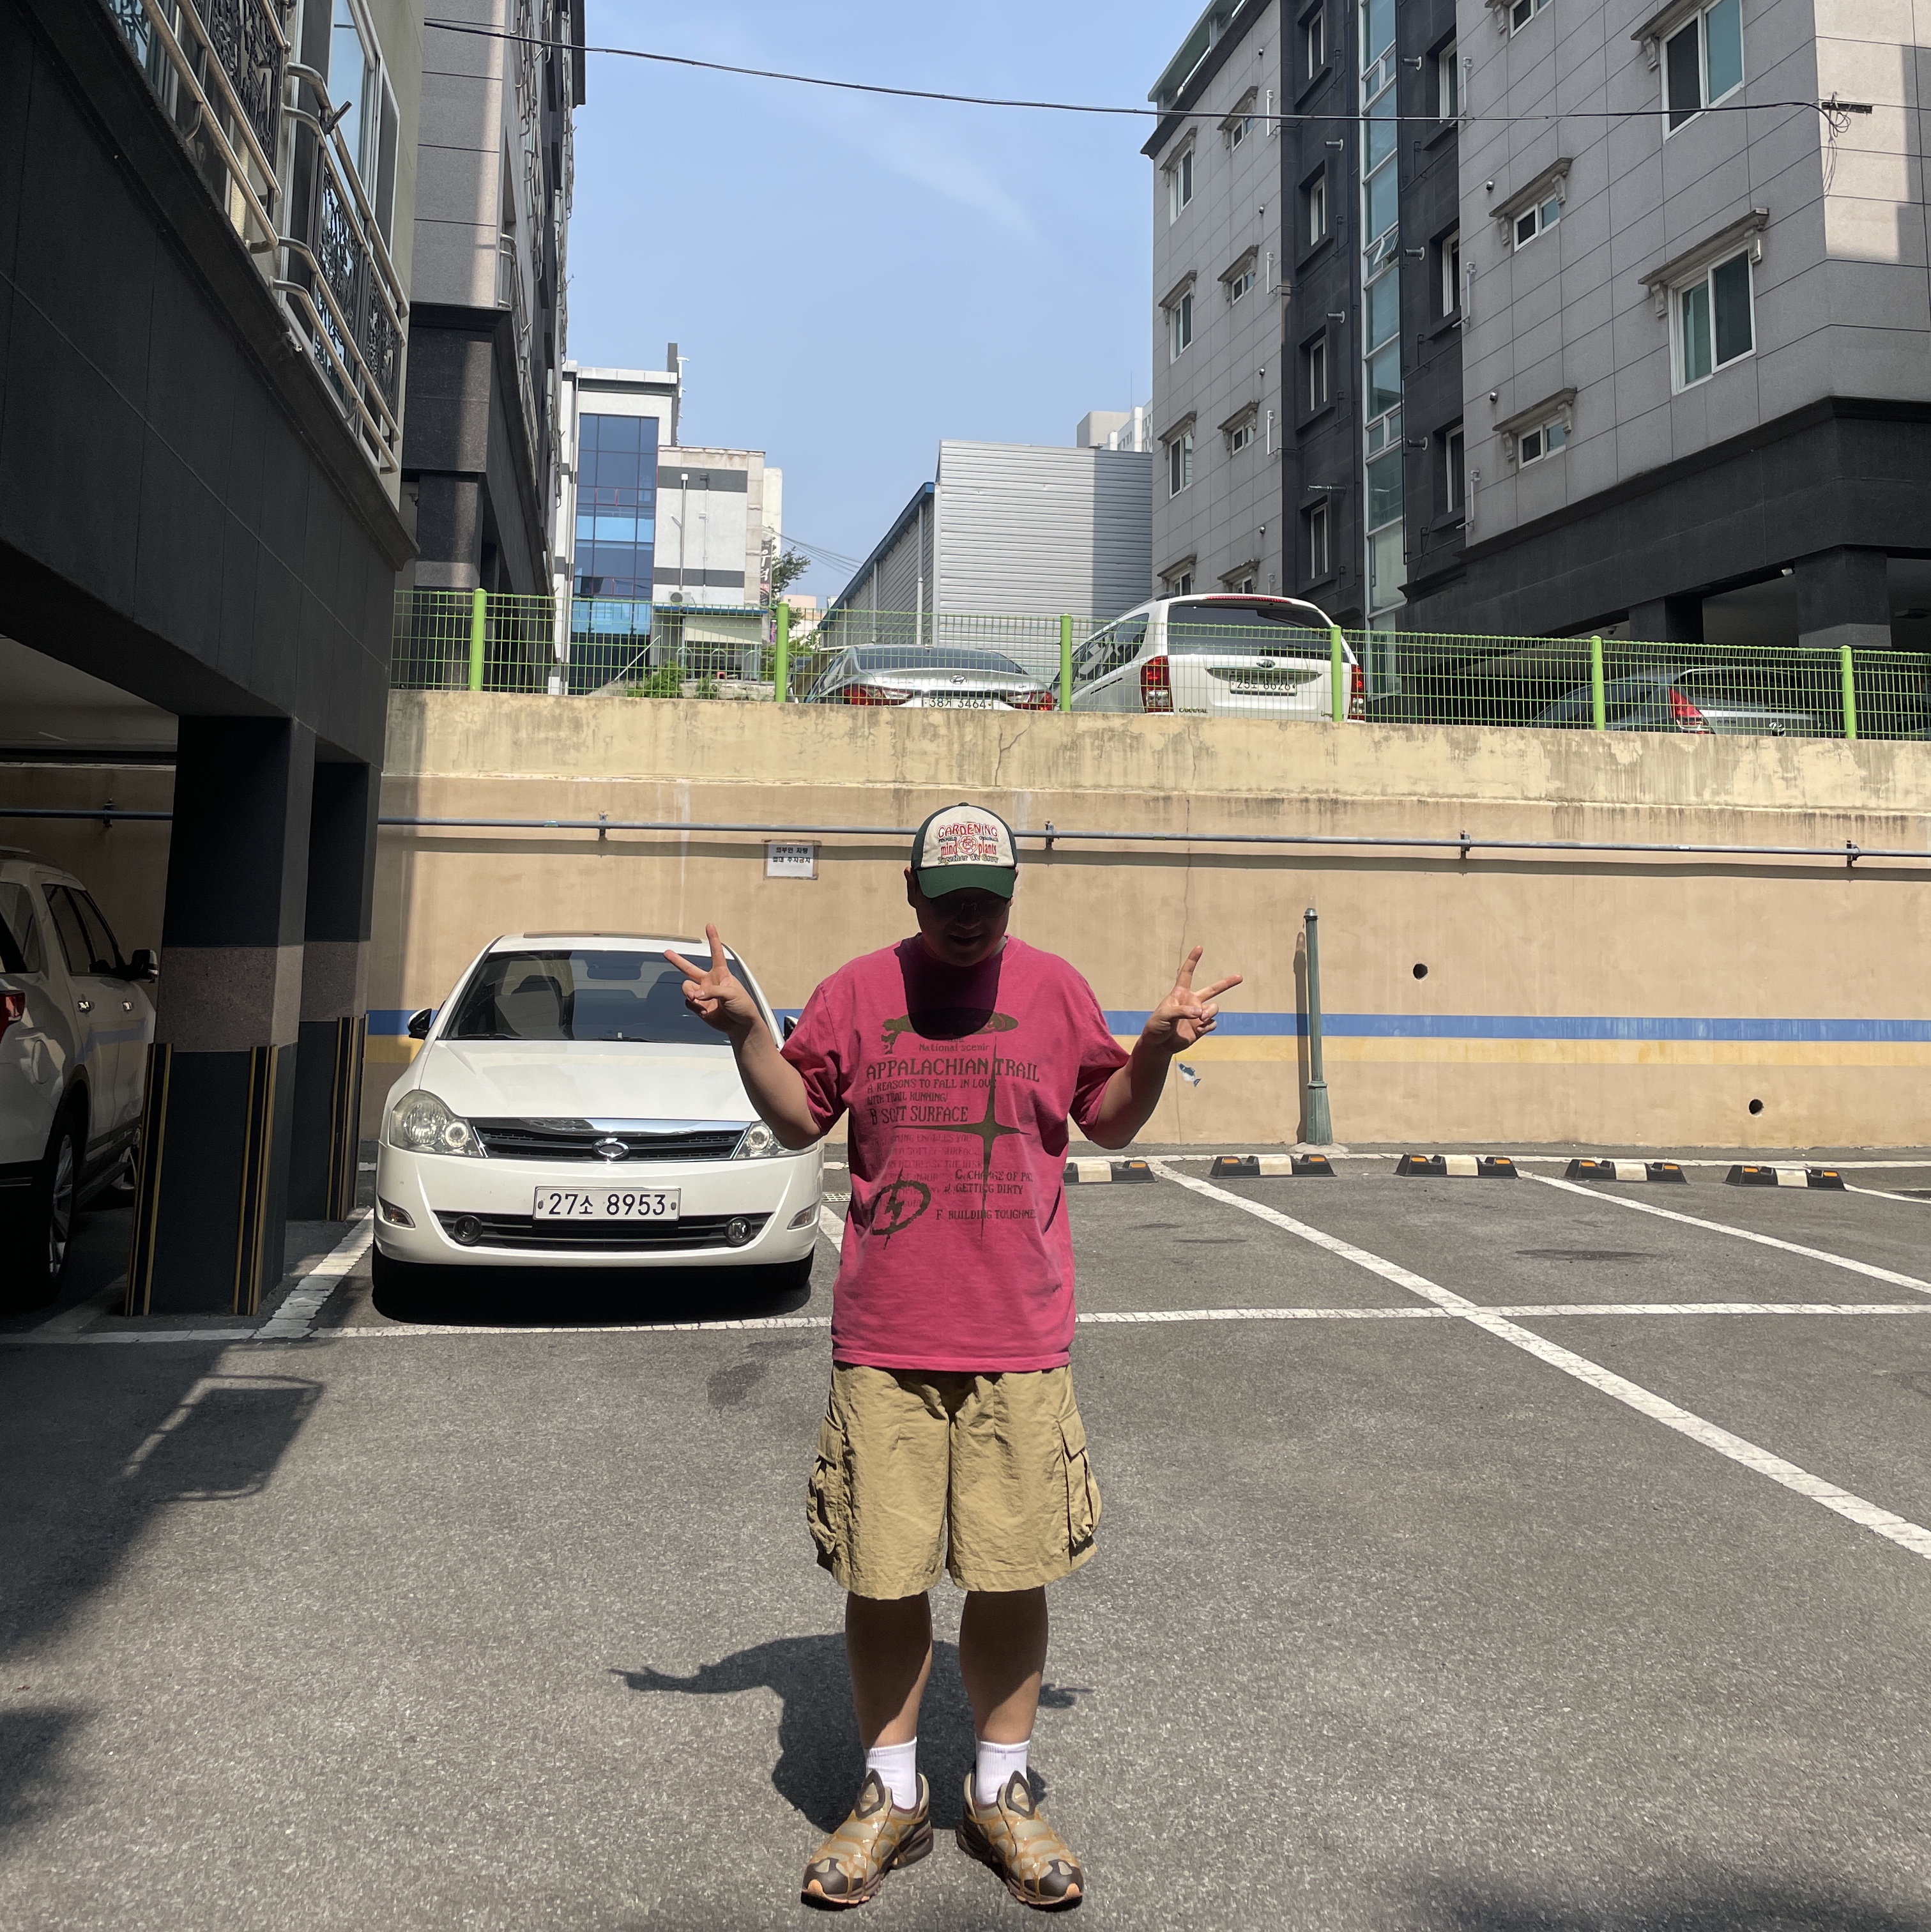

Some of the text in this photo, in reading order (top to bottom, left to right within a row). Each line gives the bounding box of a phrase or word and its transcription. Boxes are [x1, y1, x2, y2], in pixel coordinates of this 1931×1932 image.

[938, 822, 998, 838] GARDENING
[941, 838, 996, 857] mind plants
[938, 854, 968, 864] Together
[919, 1043, 958, 1052] National
[866, 1057, 1040, 1082] APPALACHIAN TRAIL
[876, 1078, 917, 1092] REASONS
[919, 1078, 931, 1089] TO
[933, 1078, 957, 1089] FALL
[960, 1078, 970, 1089] IN
[886, 1091, 907, 1103] TRAIL
[882, 1105, 907, 1123] SOFT
[910, 1106, 968, 1122] SURFACE
[1007, 1170, 1019, 1181] OF
[997, 1183, 1023, 1195] DIRTY
[549, 1193, 666, 1216] 27소 8953
